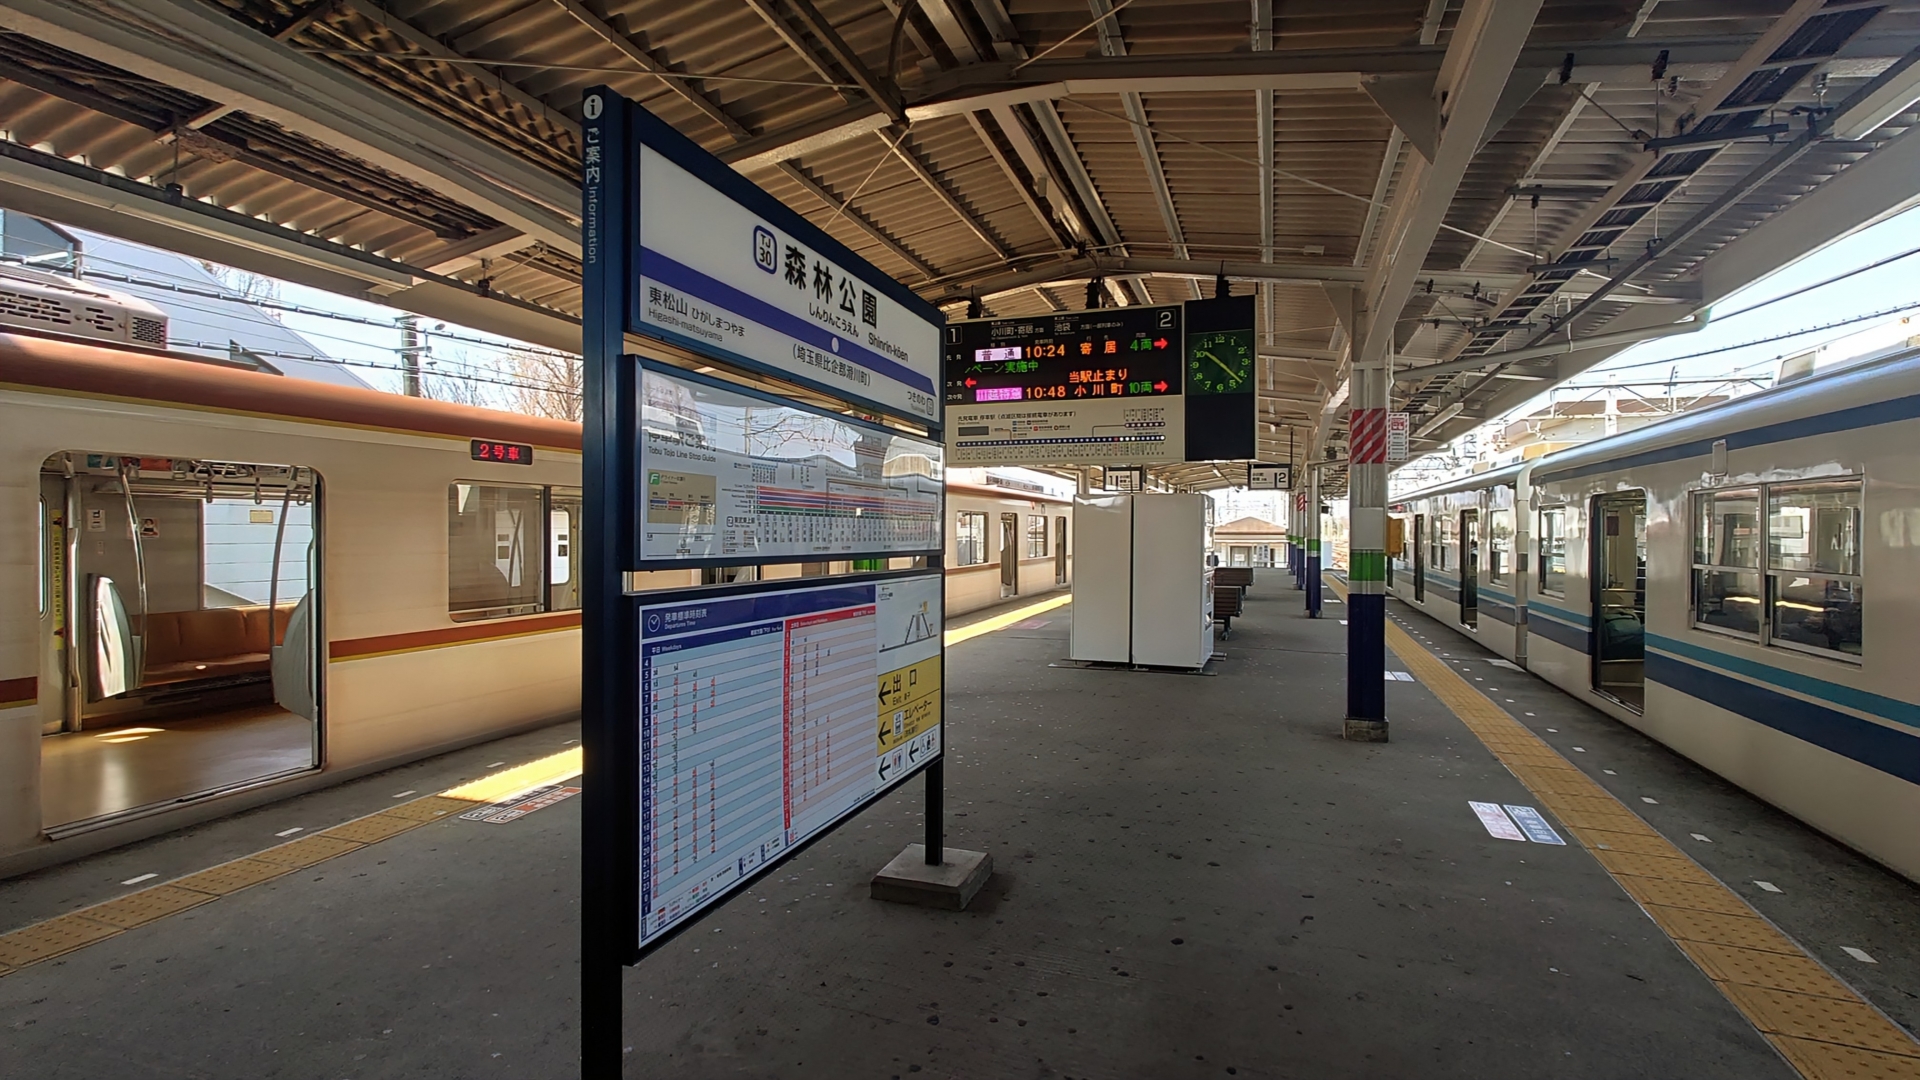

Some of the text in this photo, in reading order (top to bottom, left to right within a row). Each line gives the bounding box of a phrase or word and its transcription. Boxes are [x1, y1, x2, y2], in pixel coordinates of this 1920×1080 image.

[585, 127, 600, 184] ご案内
[588, 186, 598, 264] Information
[760, 233, 771, 248] TJ
[759, 247, 772, 266] 30
[784, 244, 877, 329] 森林公園
[649, 286, 746, 337] 東松山 ひがしまつやま
[1160, 311, 1172, 327] 2
[648, 307, 723, 342] Higashi-matsuyama
[809, 302, 859, 338] しんりんこうえん
[950, 328, 957, 343] 1
[1215, 335, 1225, 343] 12
[1026, 344, 1065, 358] 10:24
[1130, 339, 1153, 351] 4両
[1192, 361, 1199, 369] 9
[1241, 358, 1249, 366] 3
[1069, 368, 1127, 383] 当駅止まり
[1229, 379, 1236, 387] 5
[1026, 385, 1066, 399] 10:48
[1074, 383, 1123, 397] 小川町
[1129, 381, 1152, 393] 10両
[1217, 383, 1224, 391] 6
[480, 443, 519, 460] 2号車
[648, 446, 716, 462] Tobu Tojo Line Stop Guide
[1278, 472, 1286, 483] 2
[893, 669, 917, 694] 出口
[893, 695, 902, 706] Exit
[904, 700, 933, 721] エレベーター
